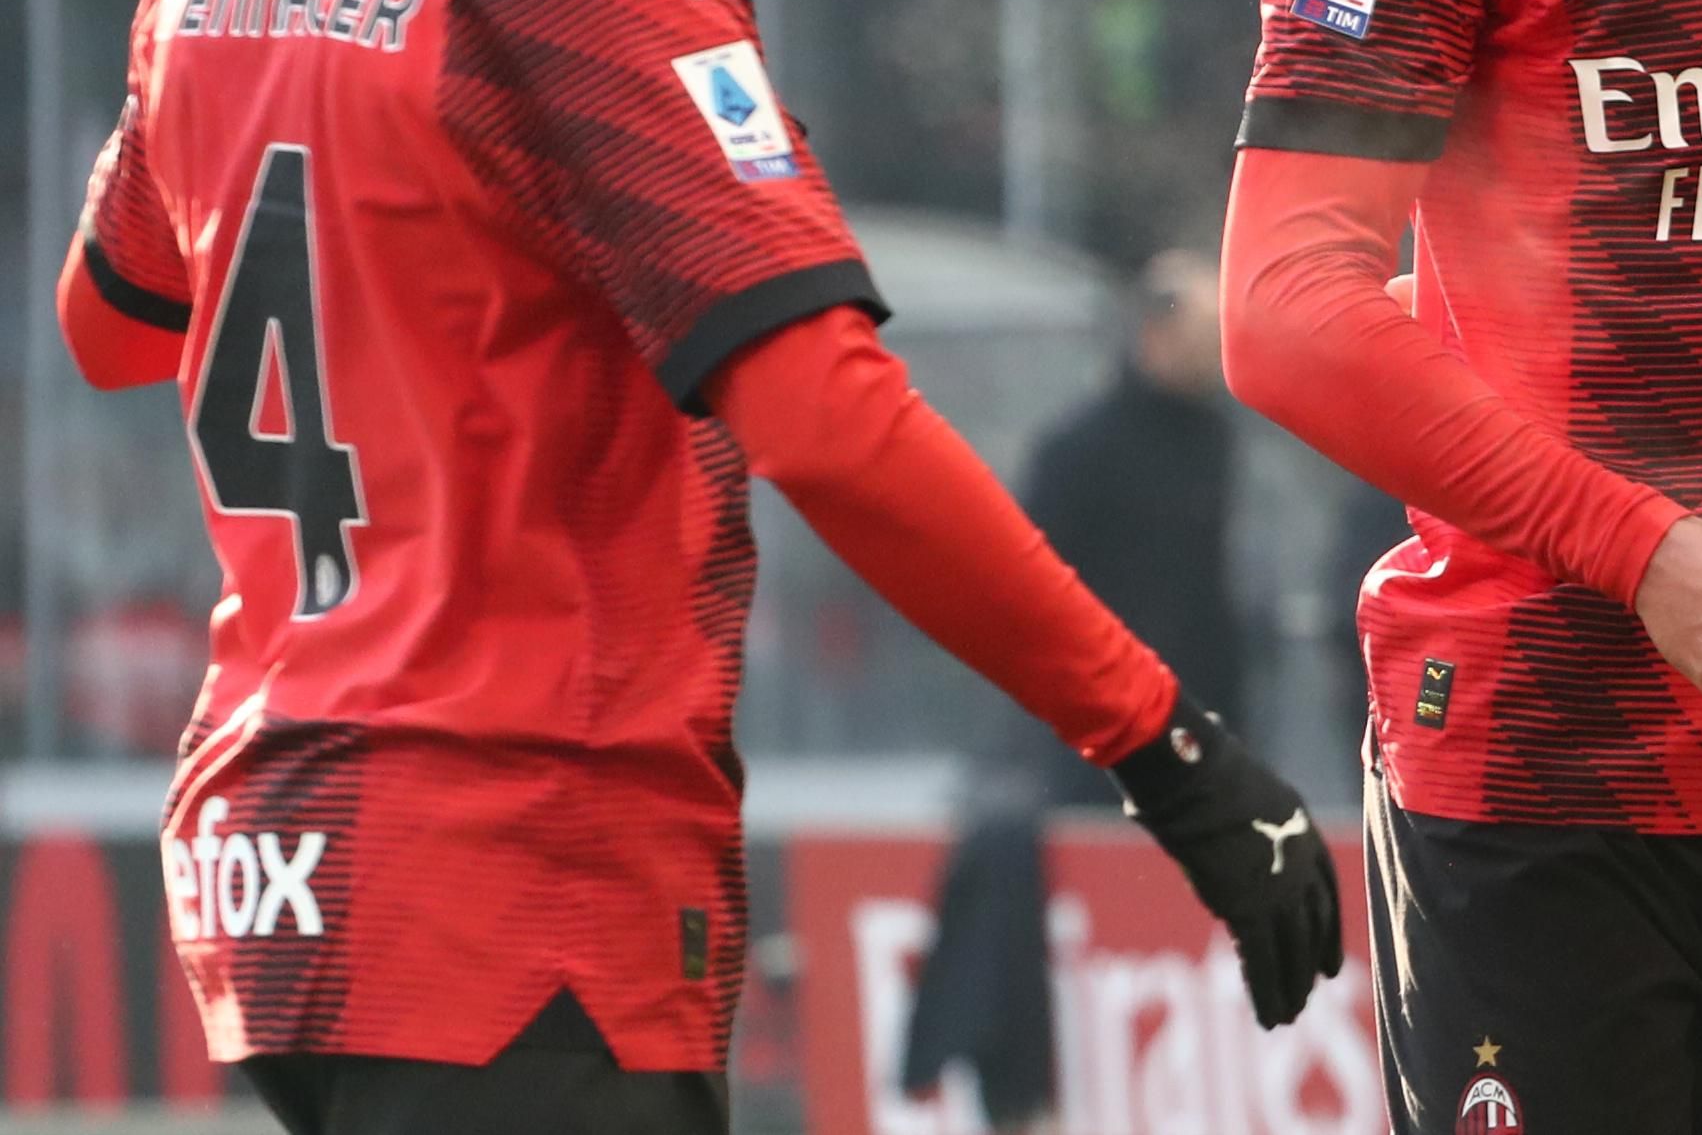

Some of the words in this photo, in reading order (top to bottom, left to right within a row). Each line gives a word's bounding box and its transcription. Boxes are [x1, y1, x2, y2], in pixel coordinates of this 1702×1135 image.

[1326, 6, 1360, 30] TIM
[187, 142, 370, 623] 4
[1468, 1081, 1507, 1106] ACM
